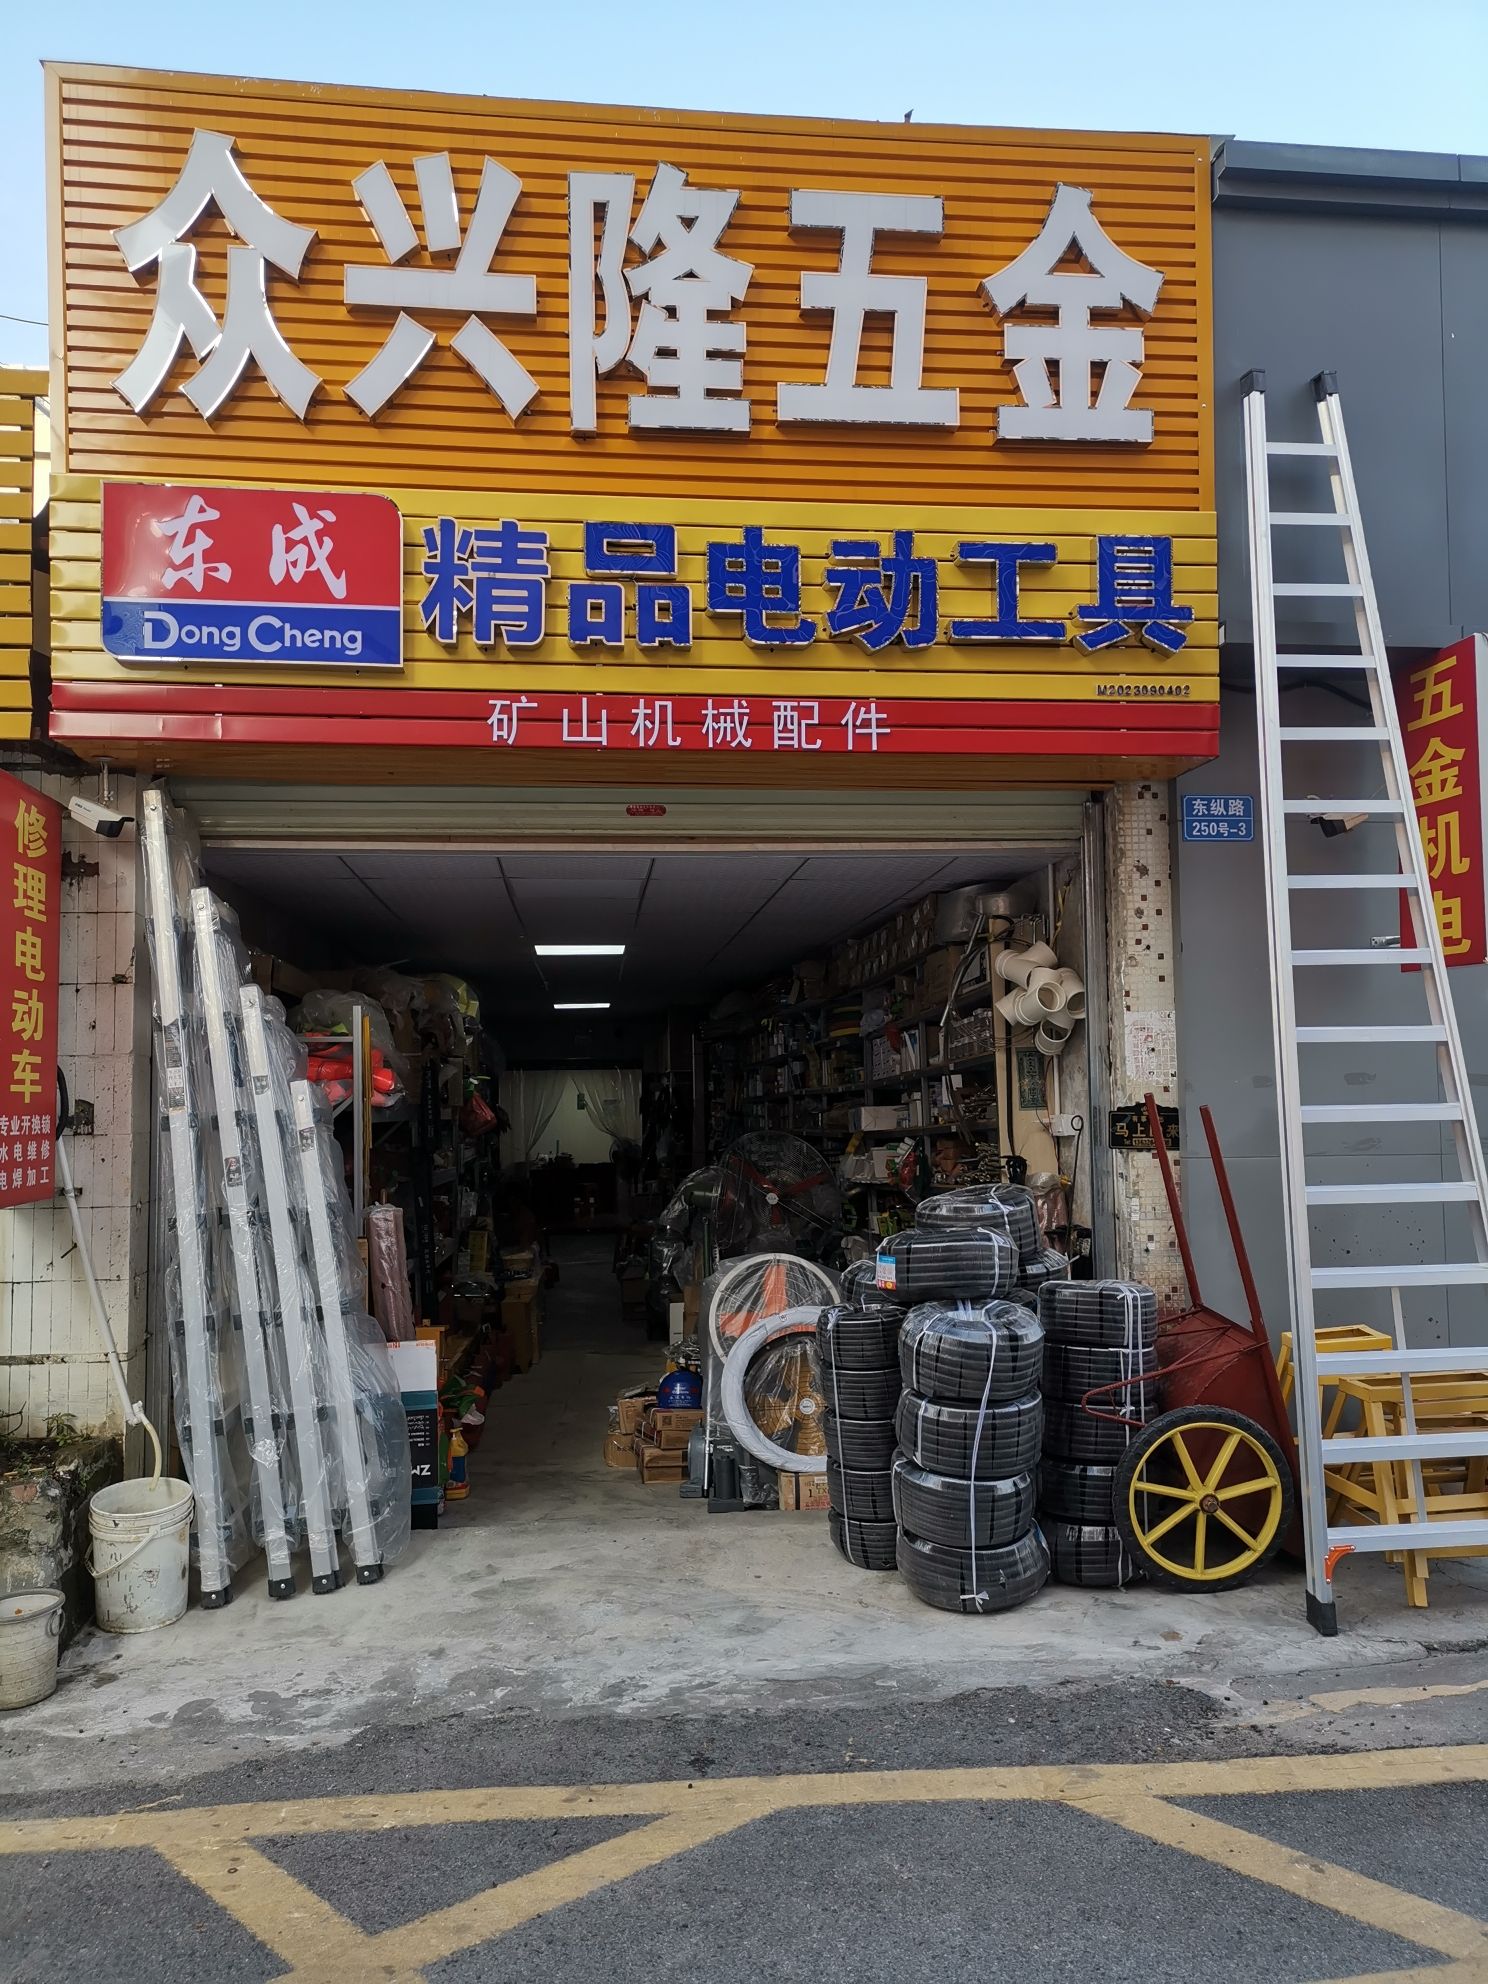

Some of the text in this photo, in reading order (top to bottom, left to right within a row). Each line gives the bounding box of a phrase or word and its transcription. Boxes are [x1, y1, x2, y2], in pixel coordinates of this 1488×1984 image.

[111, 128, 1166, 446] 众兴隆五金
[155, 494, 348, 599] 东成
[418, 516, 1196, 657] 精品电动工具
[1097, 685, 1190, 697] M2023090402
[486, 695, 891, 751] 矿山机械配件
[1192, 798, 1245, 816] 东纵路
[1192, 821, 1246, 837] 250号-3
[10, 799, 49, 1104] 修理电动车
[0, 1114, 51, 1137] 专业开换锁
[1114, 1122, 1179, 1138] 马上来
[0, 1139, 50, 1163] 水电维修
